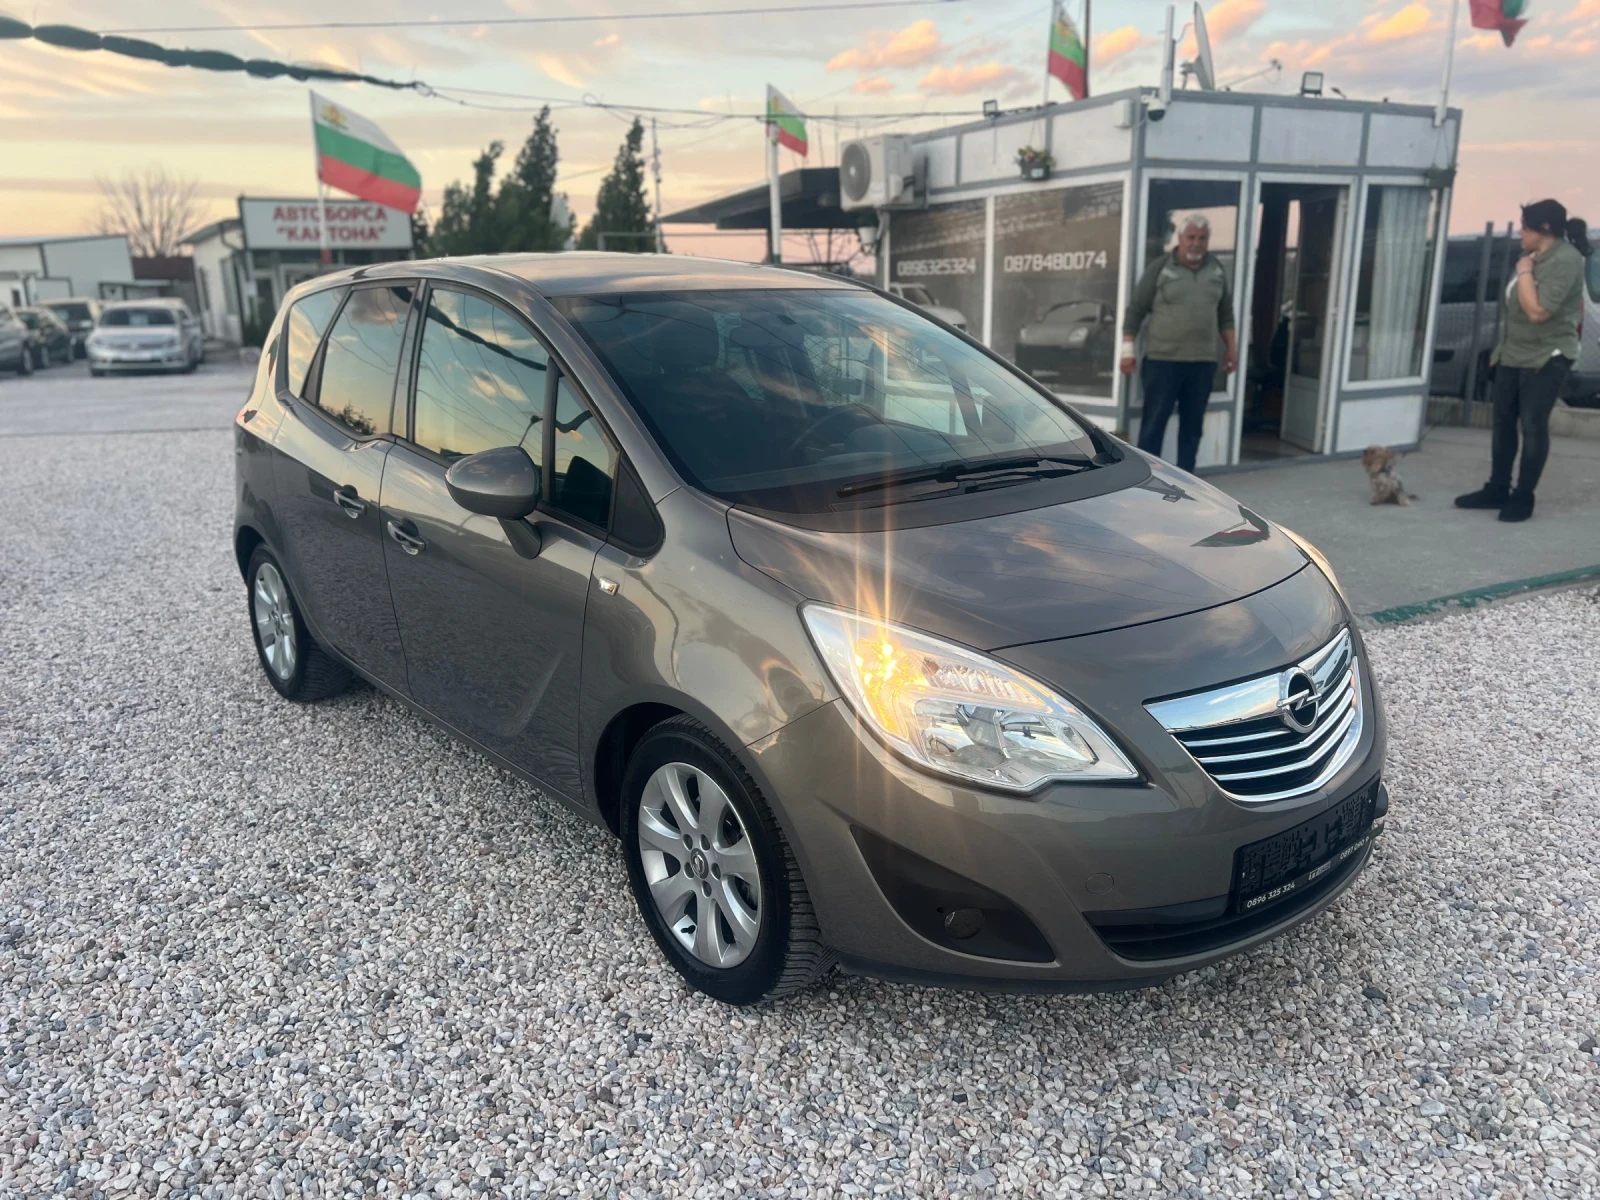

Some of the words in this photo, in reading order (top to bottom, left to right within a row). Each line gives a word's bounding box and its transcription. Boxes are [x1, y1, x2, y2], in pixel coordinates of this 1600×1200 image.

[273, 205, 387, 222] АВТОБОРСА
[1003, 250, 1107, 273] 0878480074
[1246, 894, 1267, 908] 0896
[1267, 887, 1282, 900] 325
[1282, 881, 1296, 893] 324
